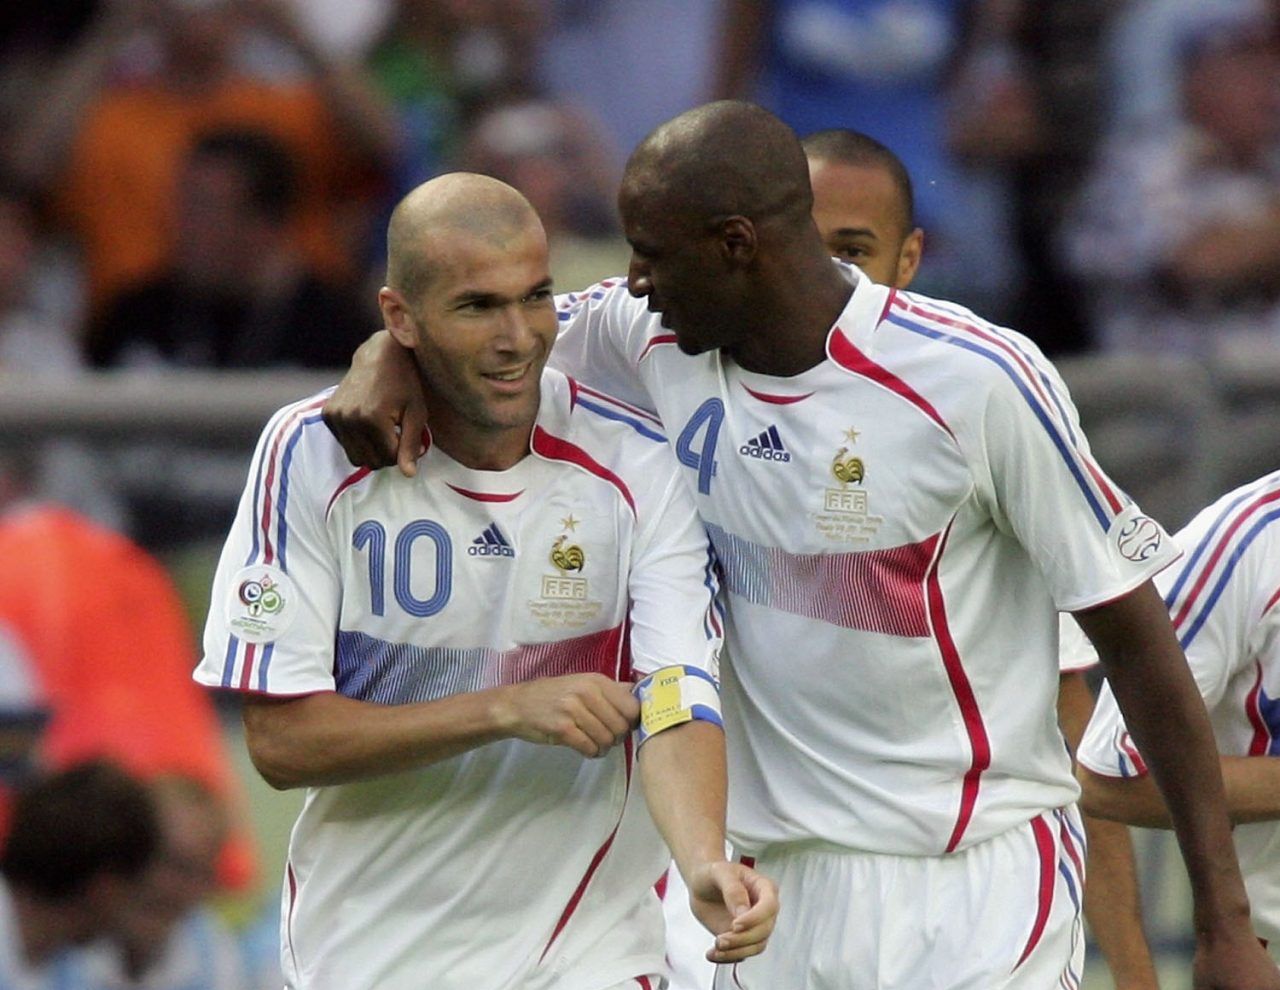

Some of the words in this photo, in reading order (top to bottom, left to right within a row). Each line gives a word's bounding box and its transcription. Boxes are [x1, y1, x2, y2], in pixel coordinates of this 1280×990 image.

[676, 397, 724, 496] 4
[740, 444, 791, 464] adidas
[352, 518, 453, 618] 10
[467, 543, 515, 558] adidas
